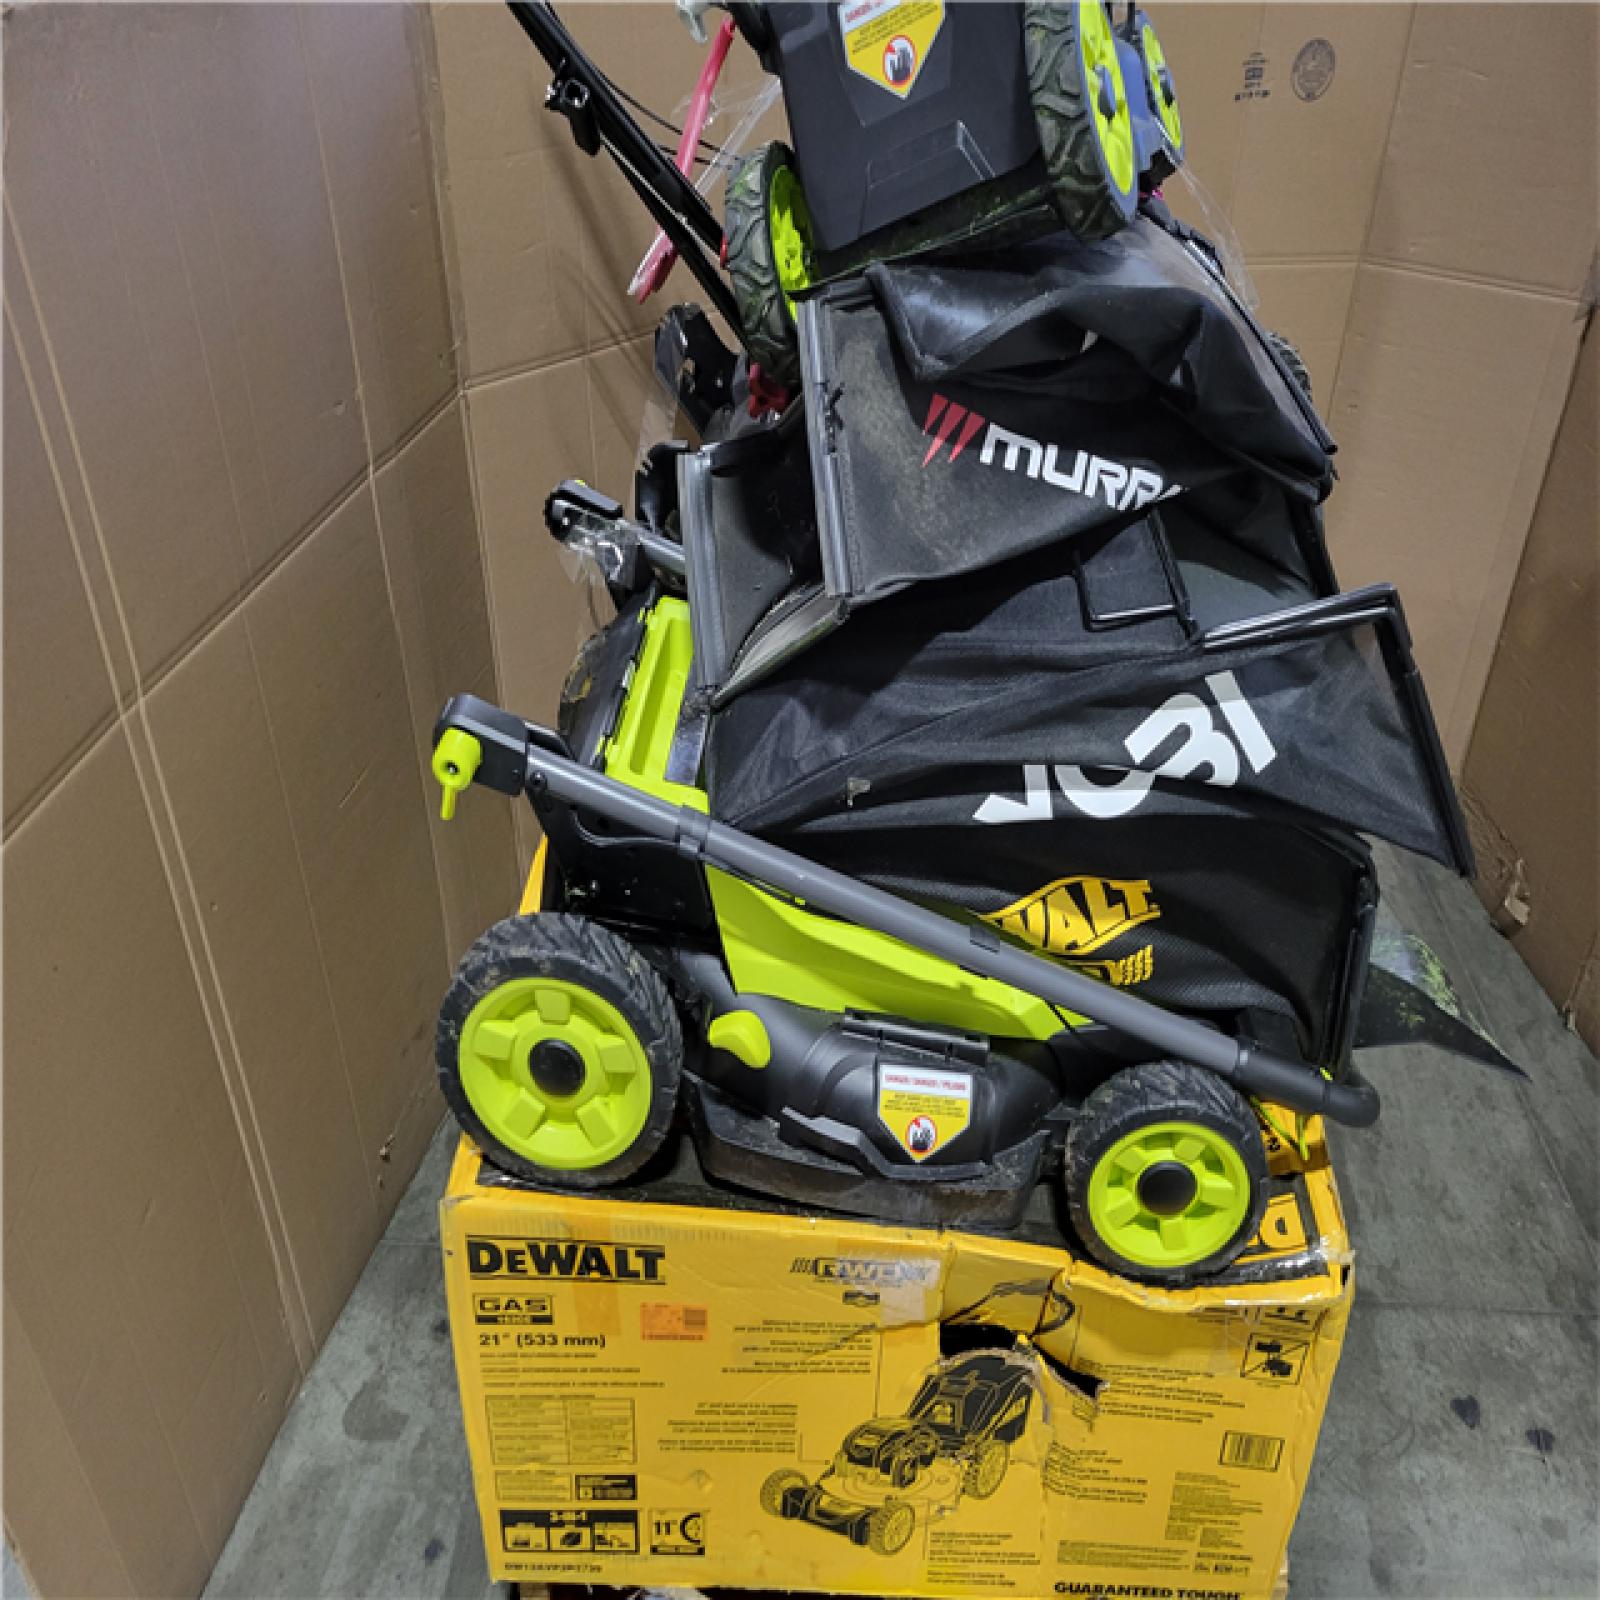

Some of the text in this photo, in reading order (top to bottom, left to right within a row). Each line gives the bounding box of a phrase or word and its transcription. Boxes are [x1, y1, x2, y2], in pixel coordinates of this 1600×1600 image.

[980, 422, 1182, 511] MURR
[468, 1241, 665, 1280] DEWALT
[480, 1298, 547, 1311] GAS
[517, 1333, 558, 1348] (533
[564, 1335, 606, 1349] mm)
[1054, 1582, 1173, 1599] GUARANTEED
